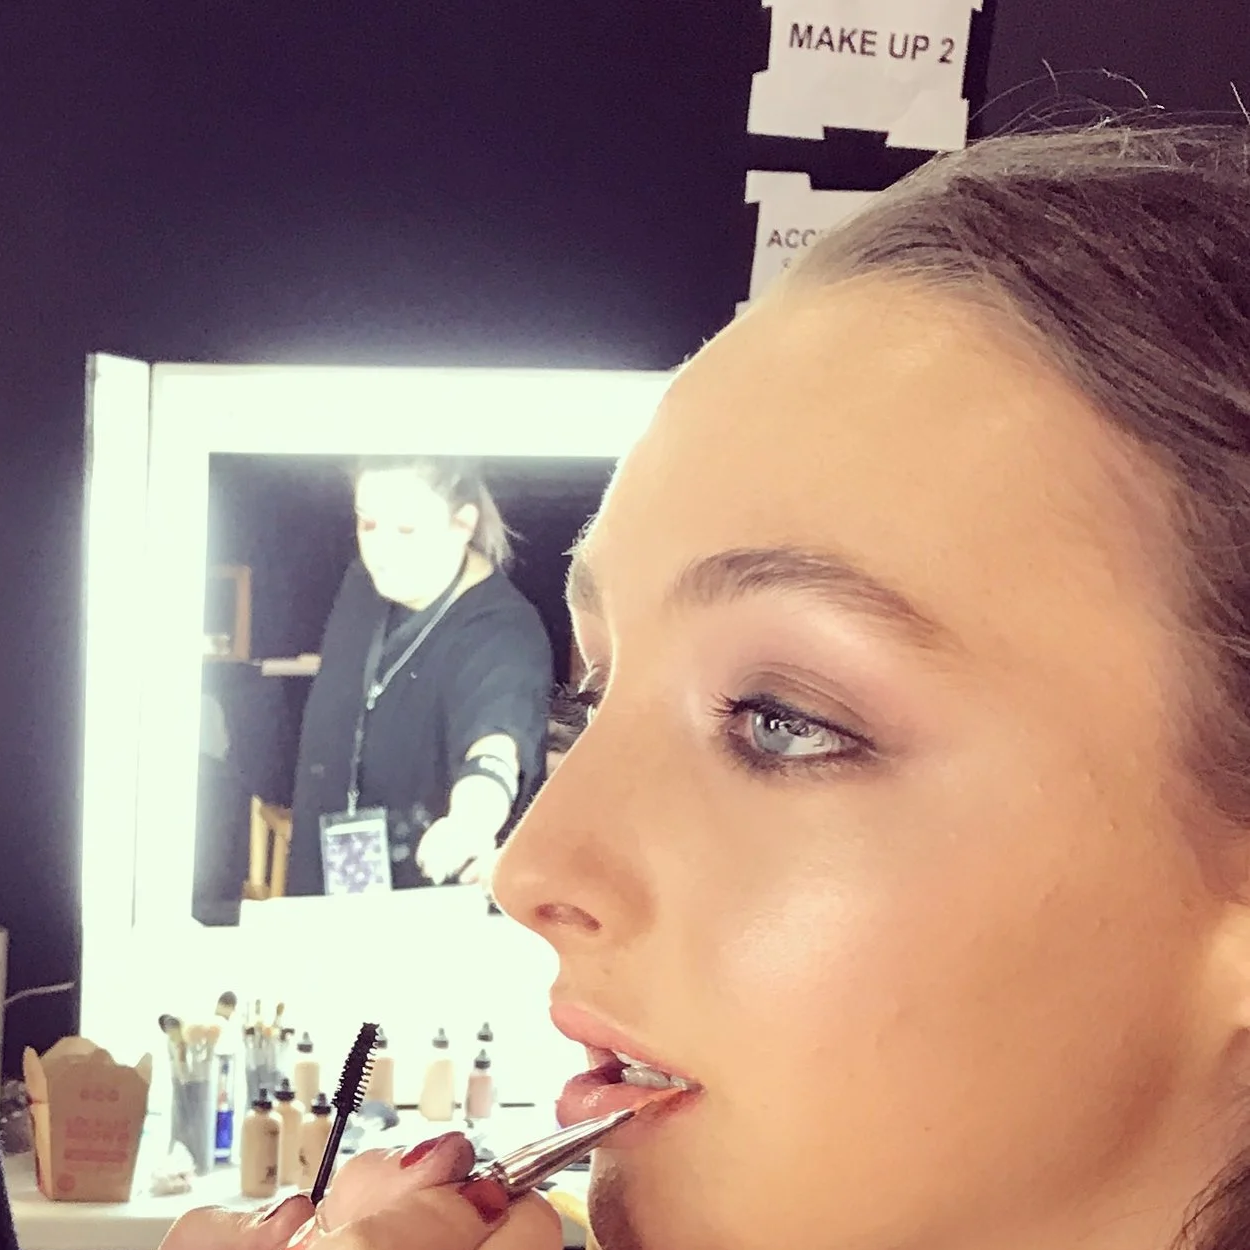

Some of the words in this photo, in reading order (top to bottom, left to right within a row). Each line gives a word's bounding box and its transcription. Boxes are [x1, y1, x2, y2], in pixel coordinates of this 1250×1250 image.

[789, 23, 877, 57] MAKE
[889, 32, 929, 60] UP
[937, 38, 956, 64] 2
